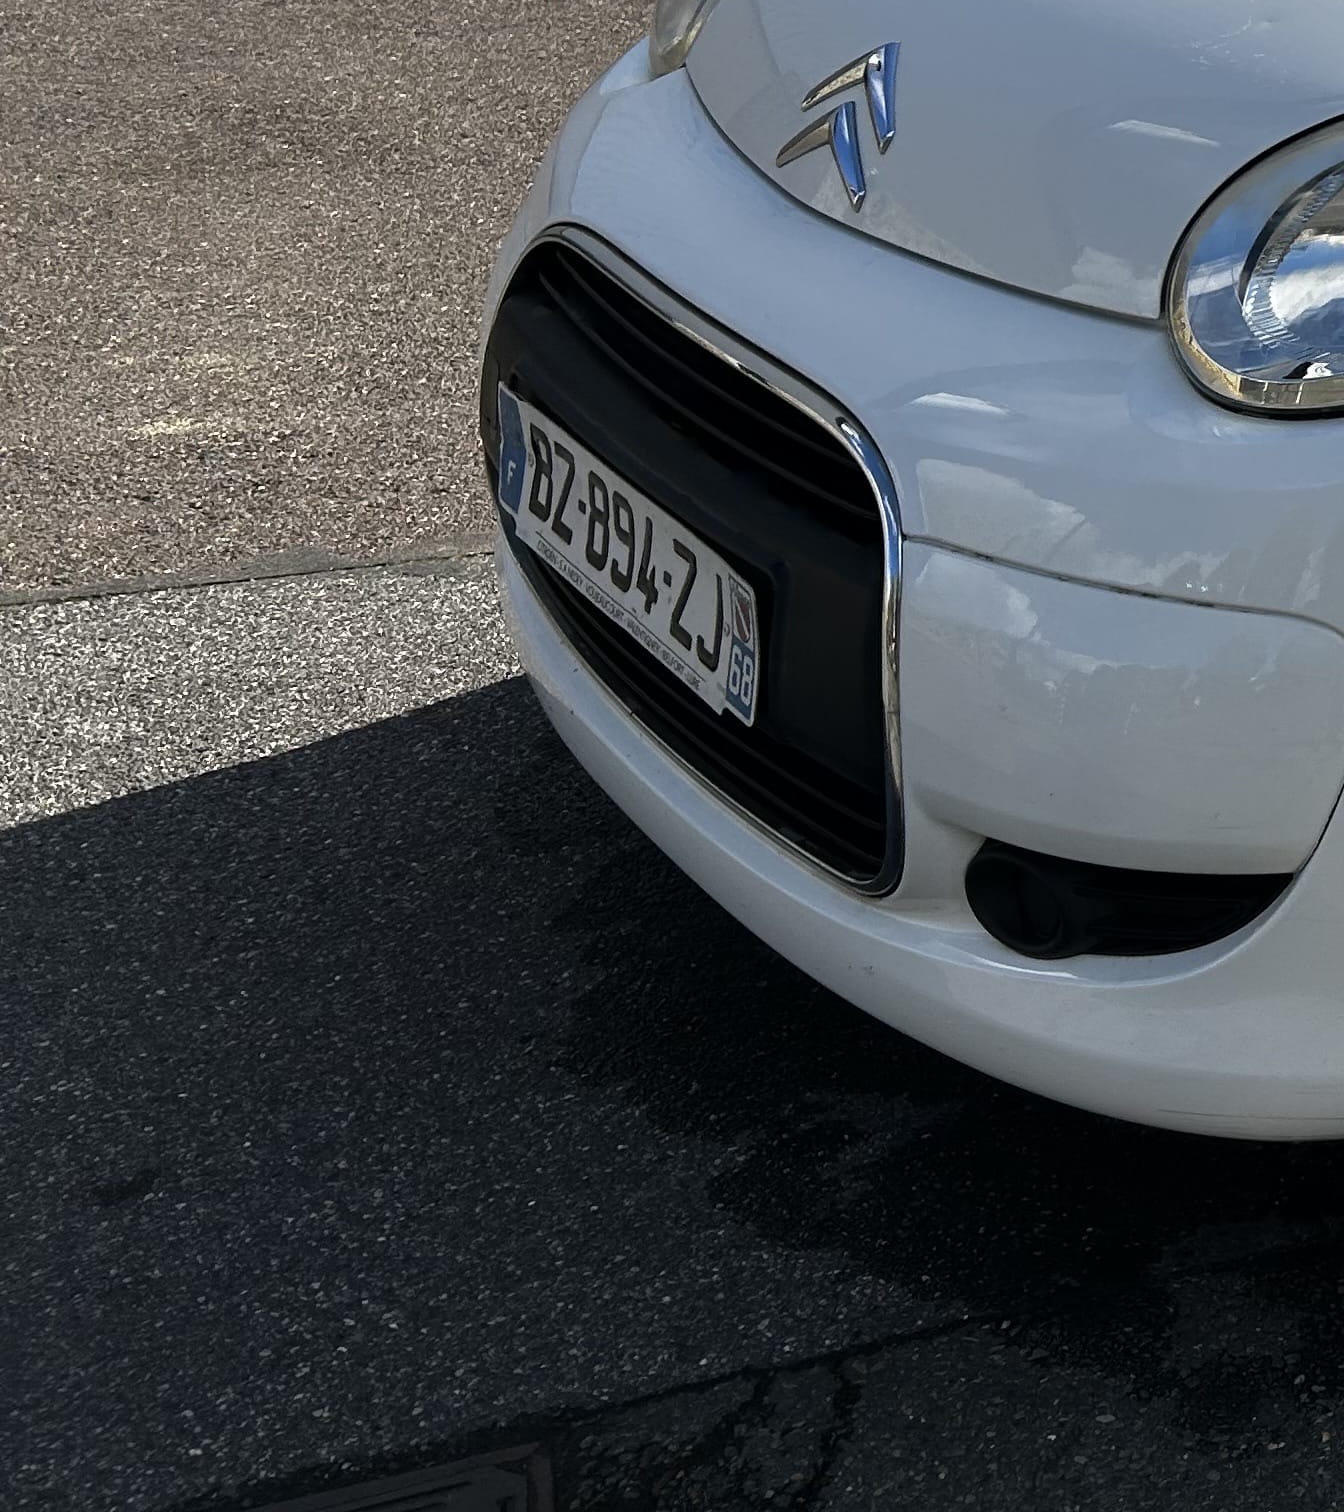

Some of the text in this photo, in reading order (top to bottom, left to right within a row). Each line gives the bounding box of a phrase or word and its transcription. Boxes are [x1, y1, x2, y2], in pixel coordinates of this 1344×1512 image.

[507, 459, 517, 486] F
[528, 422, 725, 673] BZ-894-ZJ
[727, 644, 754, 707] 68
